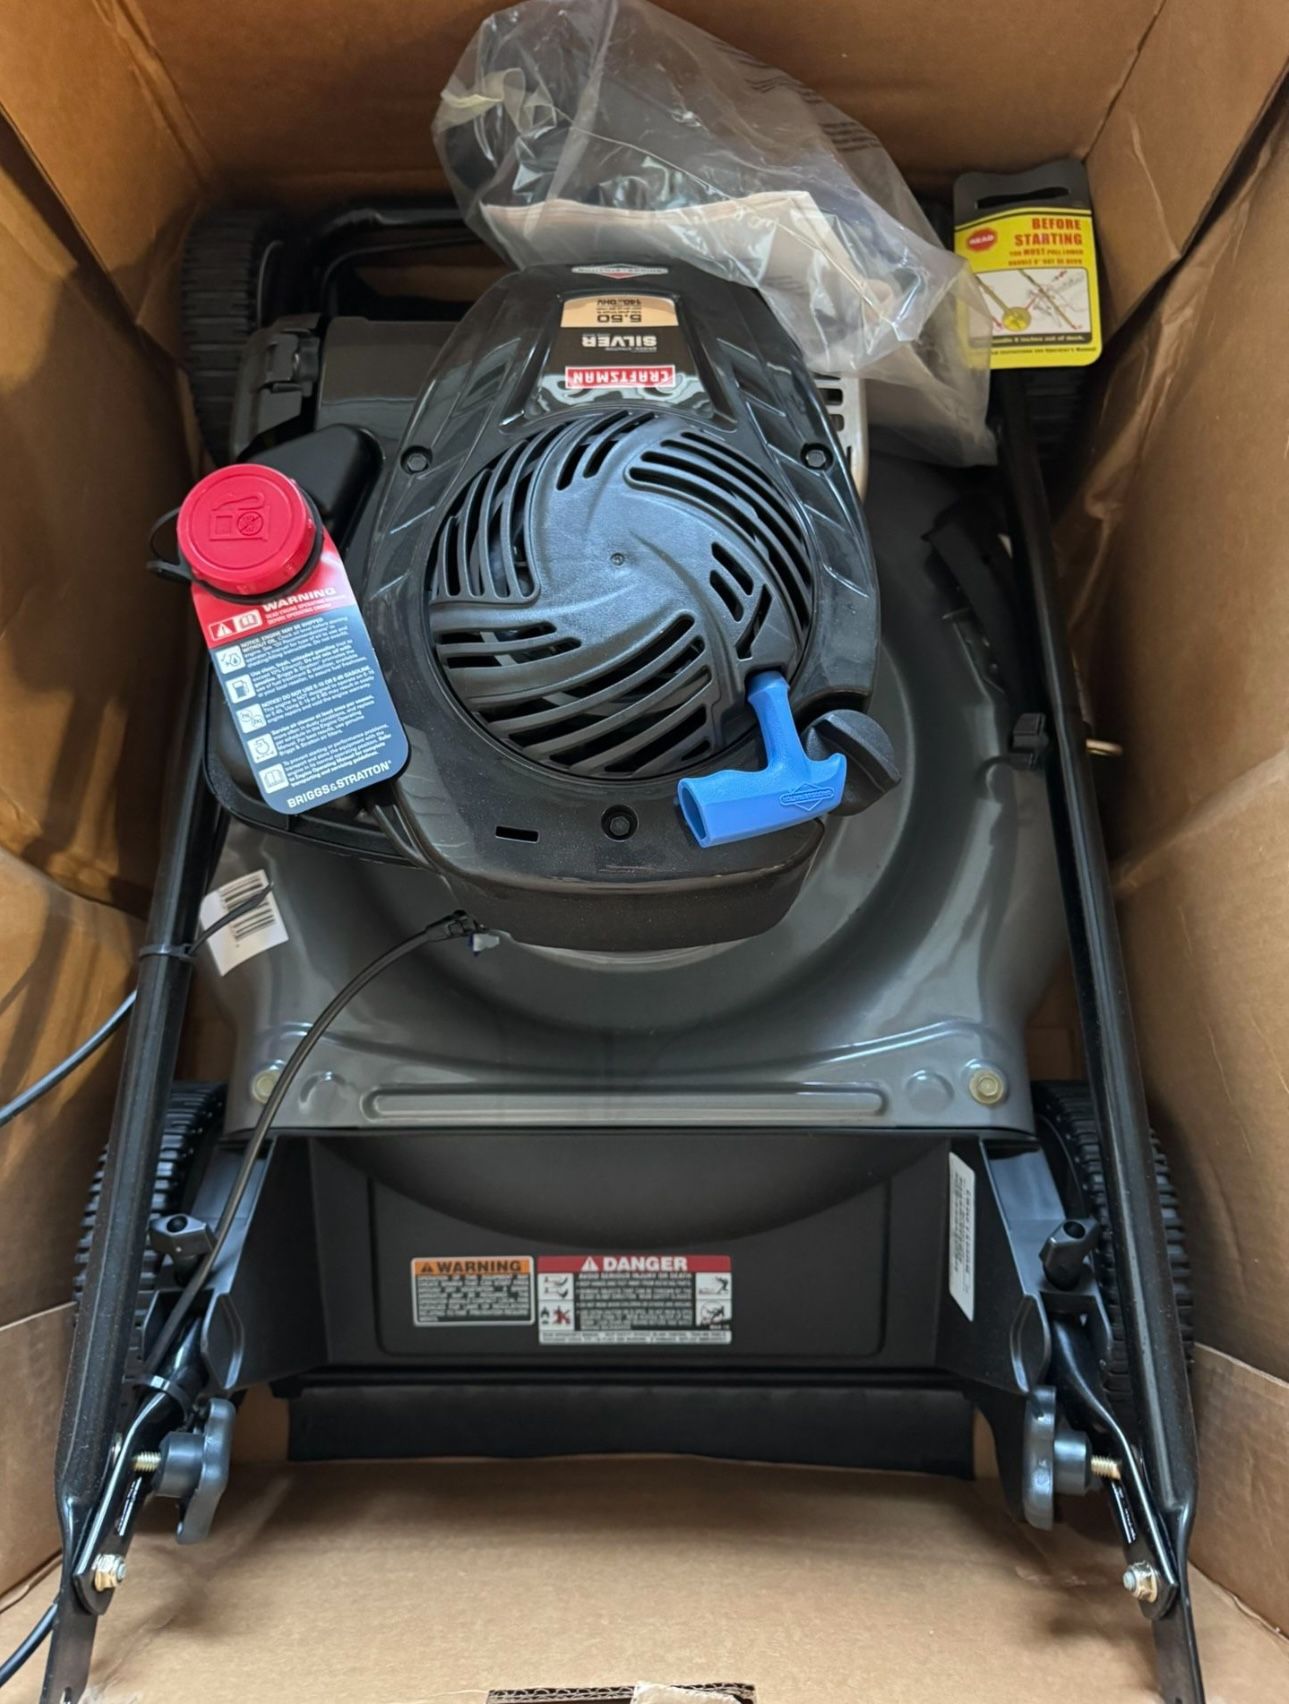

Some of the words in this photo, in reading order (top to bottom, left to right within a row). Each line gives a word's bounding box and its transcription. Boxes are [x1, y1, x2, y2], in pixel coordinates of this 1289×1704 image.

[1032, 217, 1081, 232] BEFORE
[969, 235, 994, 245] READ
[1015, 232, 1082, 246] STARTING
[597, 314, 642, 323] 5.50
[582, 336, 657, 347] SILVER
[573, 370, 669, 384] CRAFTSMAN
[263, 587, 336, 612] WARNING
[436, 1260, 521, 1273] WARNING
[603, 1257, 688, 1271] DANGER
